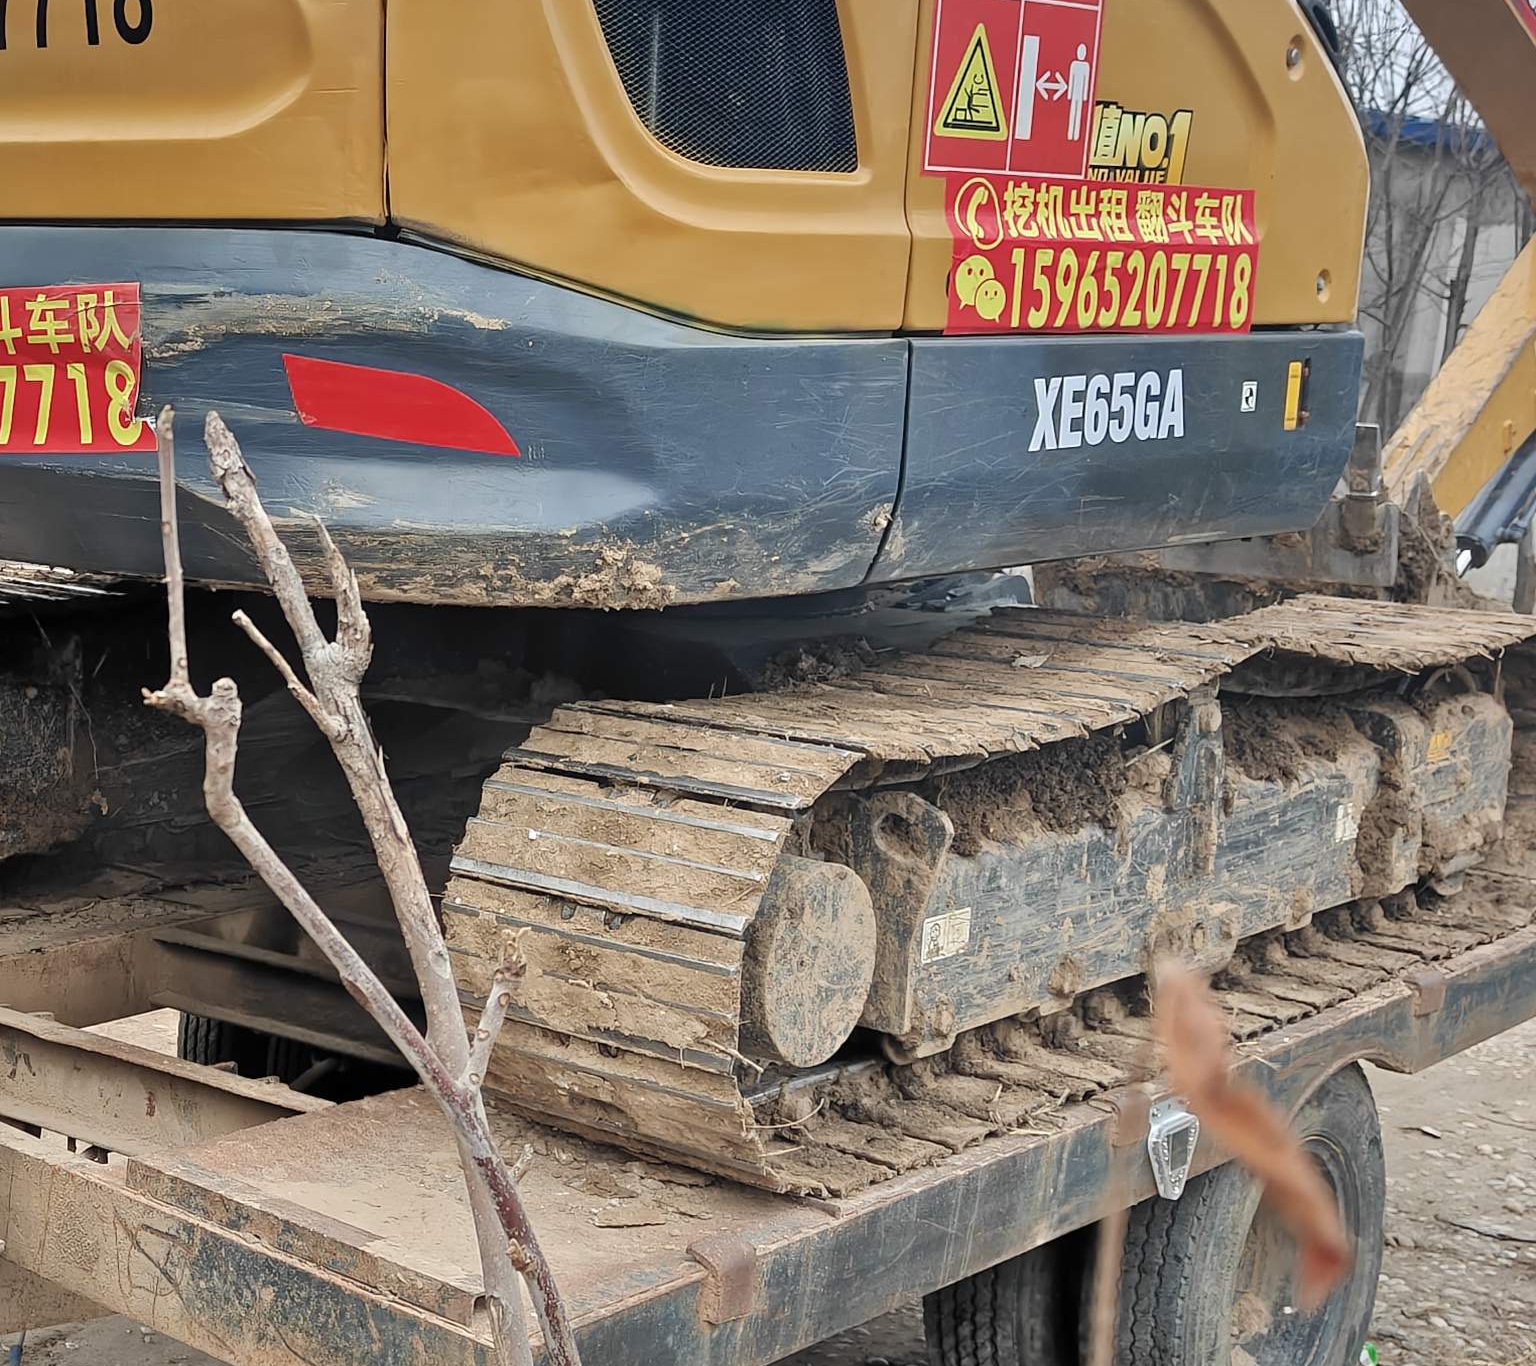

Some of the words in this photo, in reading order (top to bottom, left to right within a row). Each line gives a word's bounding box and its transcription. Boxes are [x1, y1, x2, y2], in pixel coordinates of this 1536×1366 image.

[1003, 181, 1134, 240] 挖机出租
[1135, 189, 1253, 246] 翻斗车队
[1010, 246, 1252, 329] 15965207718
[1027, 369, 1185, 452] XE65GA
